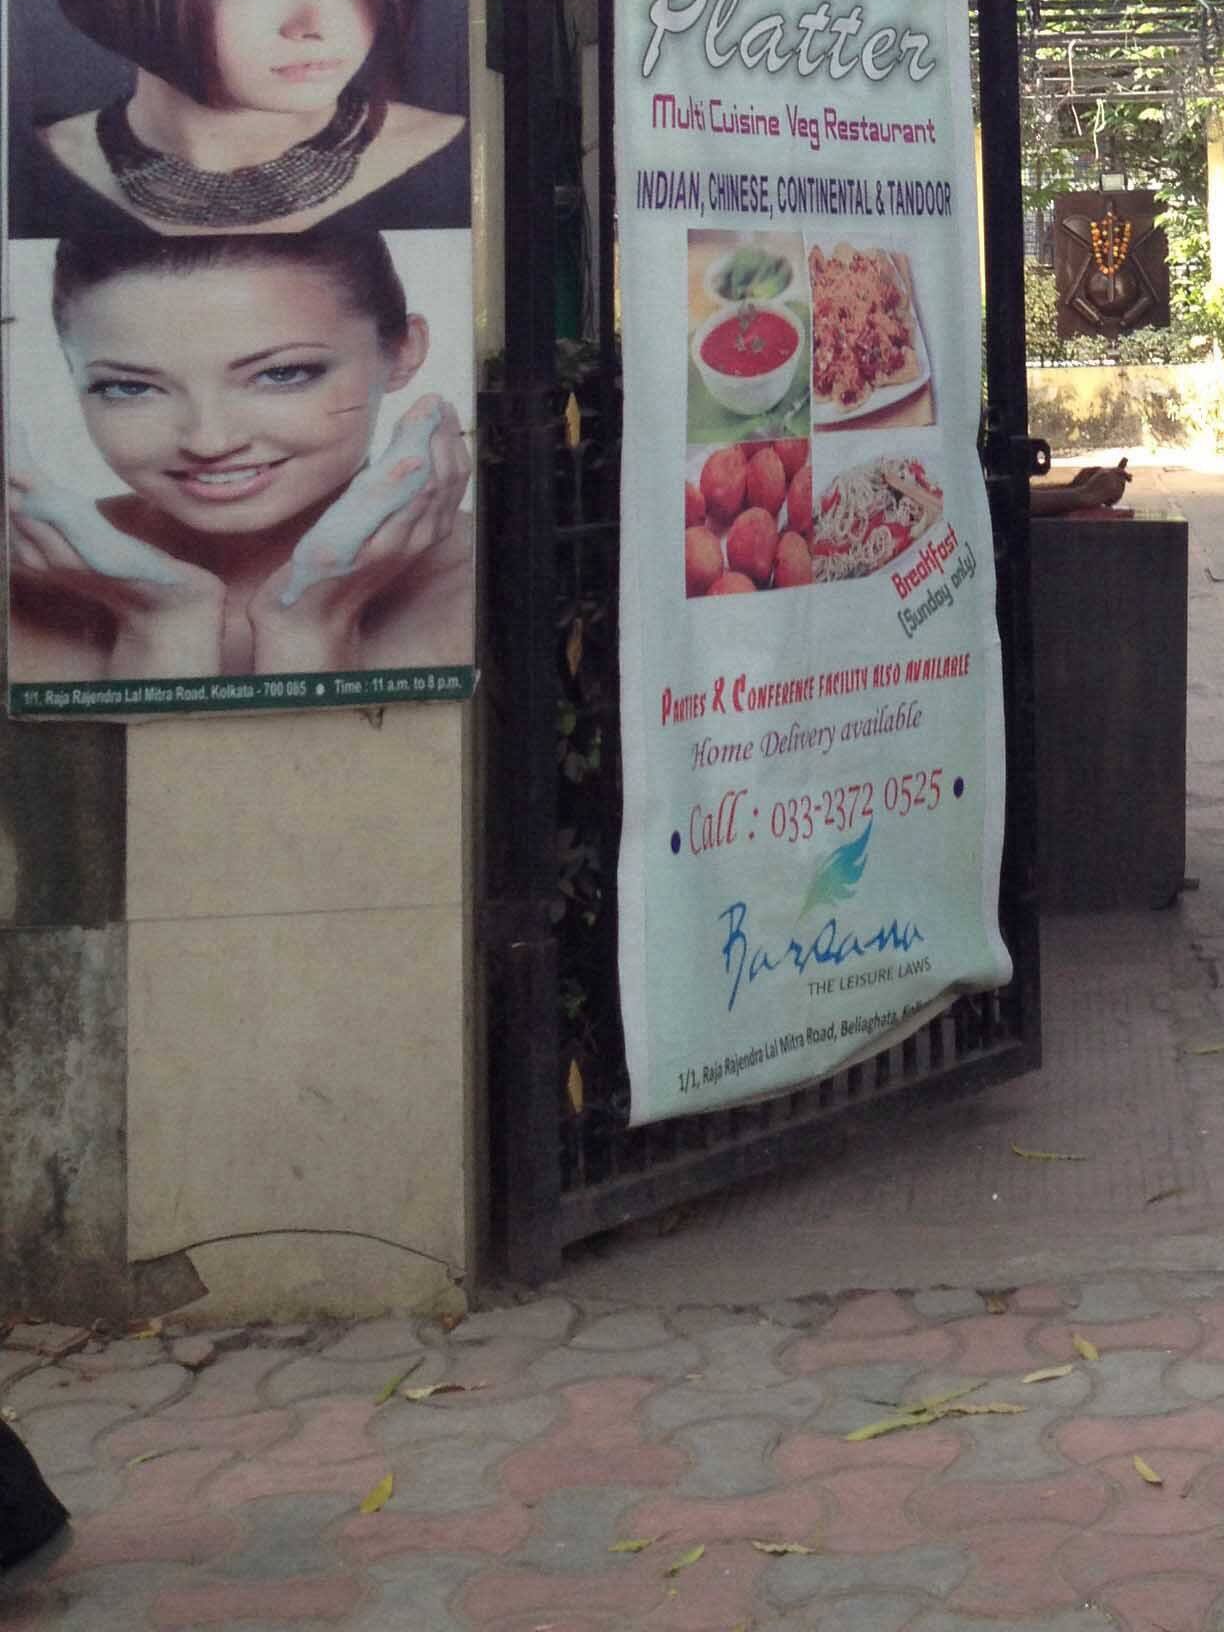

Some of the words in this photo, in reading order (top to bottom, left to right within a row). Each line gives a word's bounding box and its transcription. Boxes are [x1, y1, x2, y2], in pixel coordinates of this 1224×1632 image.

[652, 93, 704, 131] Multi
[709, 99, 780, 137] Cuisine
[785, 104, 820, 151] Veg
[824, 108, 936, 145] Restaurant
[636, 171, 705, 219] INDIAN,
[708, 175, 774, 220] CHINESE,
[777, 180, 872, 214] CONTINENTAL
[876, 183, 886, 214] &
[887, 181, 952, 218] TANDOOR
[891, 522, 959, 602] Breakfast
[334, 678, 362, 695] Time
[872, 663, 901, 690] ALSO
[691, 736, 753, 772] Home
[760, 720, 836, 758] Delivery
[841, 699, 923, 742] available
[689, 789, 749, 856] Call
[771, 781, 875, 843] 033-2372
[884, 767, 943, 817] 0525
[717, 901, 925, 1012] Barsana
[808, 980, 835, 998] THE
[840, 967, 894, 992] LEISURE
[703, 1062, 724, 1085] Raja
[724, 1048, 764, 1081] Rajendra
[765, 1041, 778, 1062] Lal
[779, 1030, 805, 1058] Mitra
[805, 1022, 838, 1048] Road,
